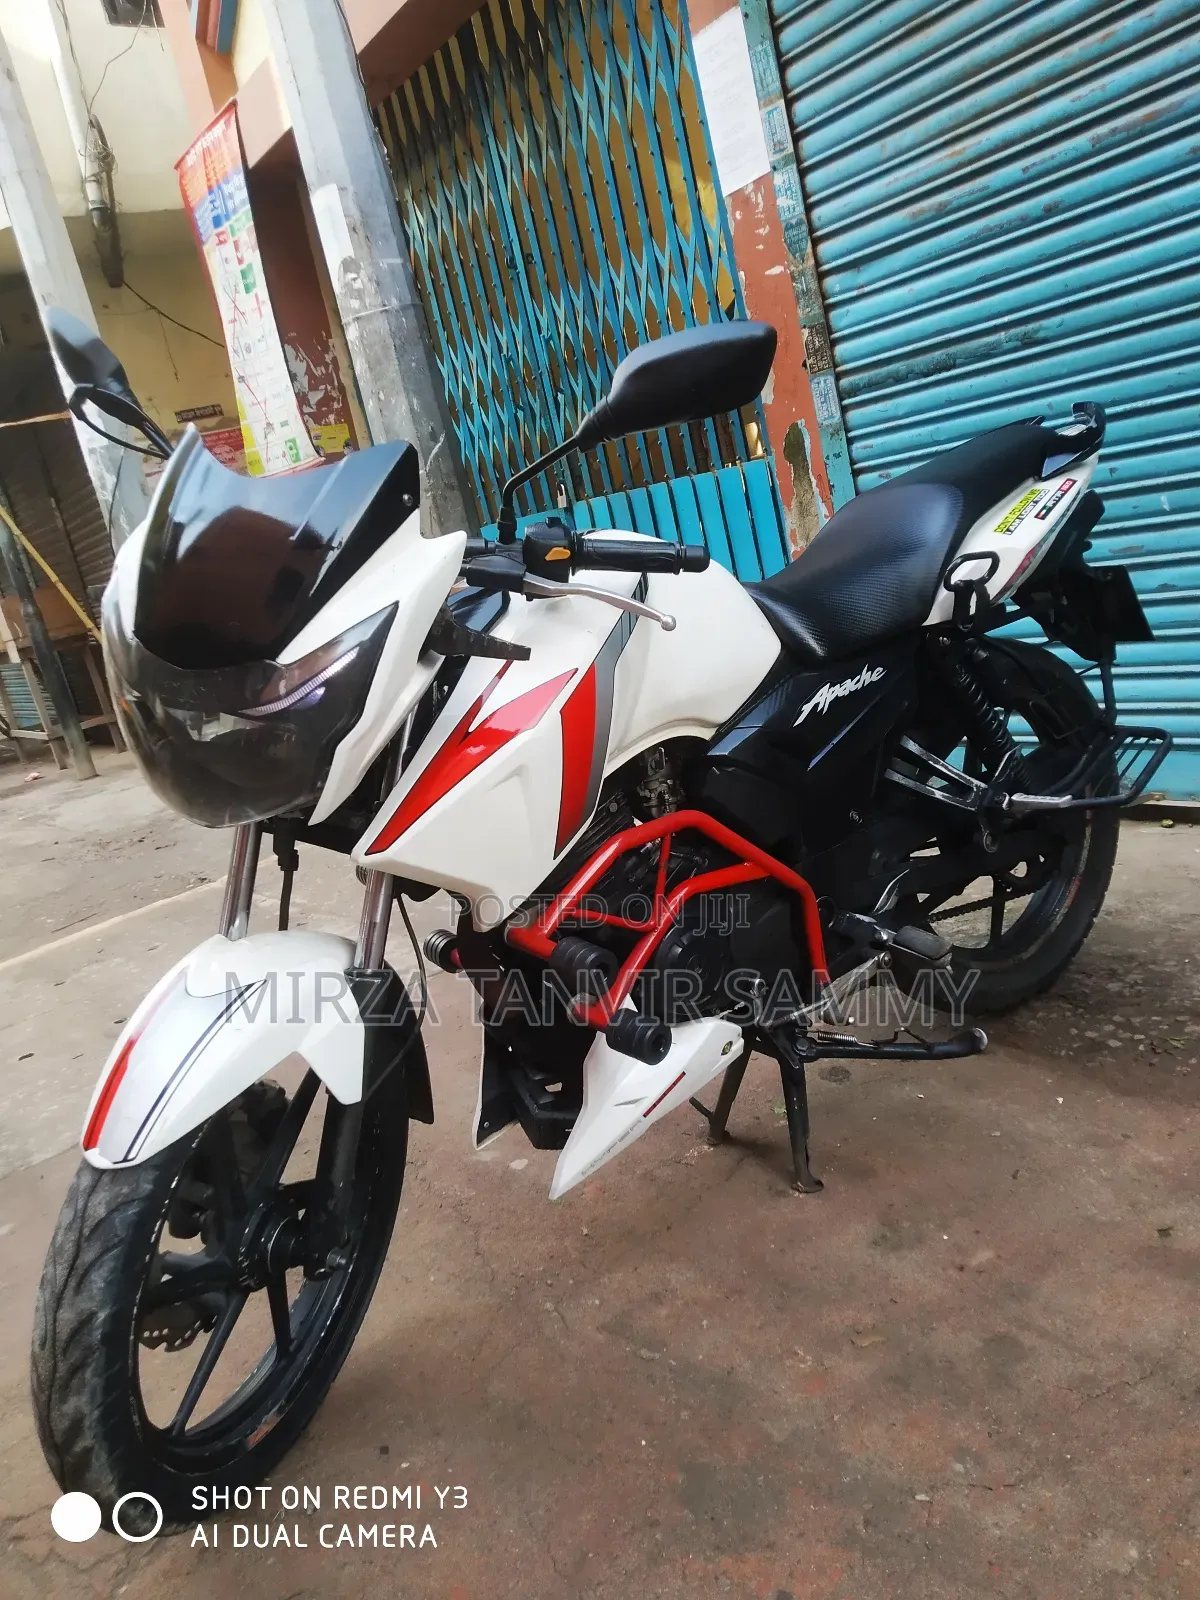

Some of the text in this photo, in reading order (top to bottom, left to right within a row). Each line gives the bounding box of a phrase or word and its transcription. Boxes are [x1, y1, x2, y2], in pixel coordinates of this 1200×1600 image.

[1009, 494, 1034, 516] FOLLOW
[1017, 501, 1036, 519] LOST
[793, 663, 887, 728] Apache
